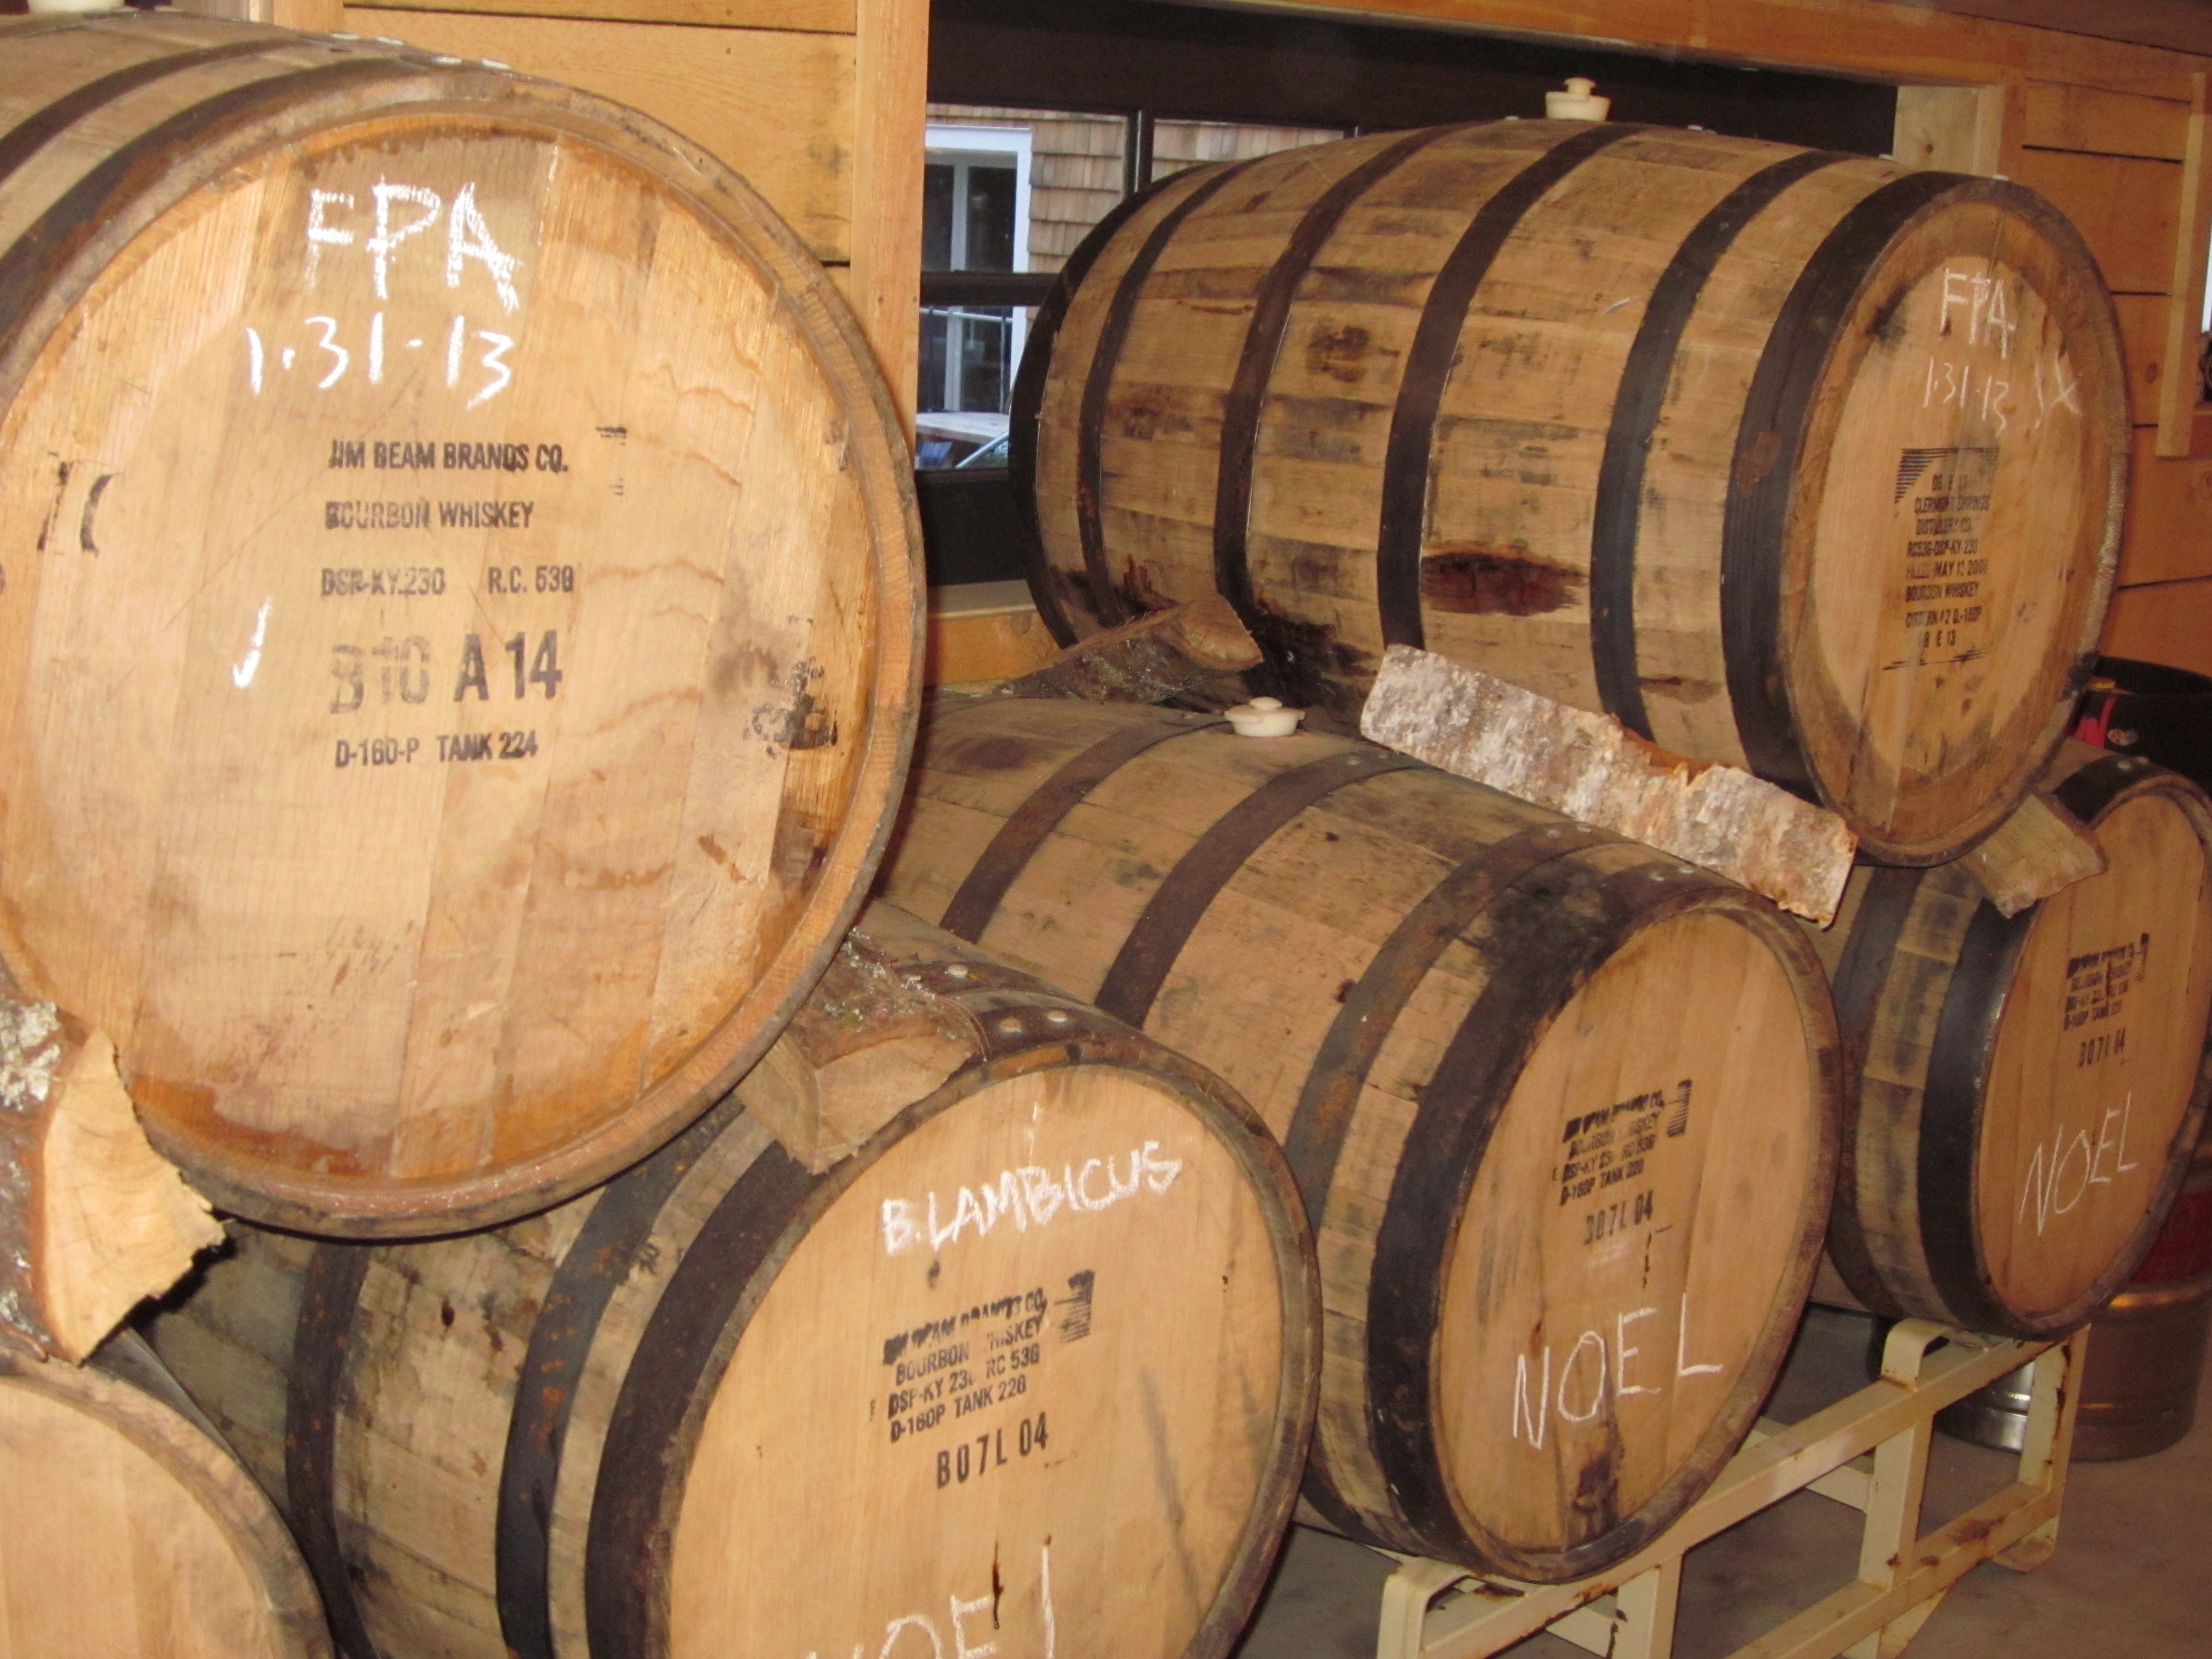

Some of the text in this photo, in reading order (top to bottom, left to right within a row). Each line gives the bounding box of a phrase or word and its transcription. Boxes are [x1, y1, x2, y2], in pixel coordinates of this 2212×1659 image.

[306, 176, 523, 314] FPA
[1941, 268, 2016, 359] FPA
[328, 440, 568, 473] JIM BEAM BRANDS CO.
[325, 500, 535, 529] BOURBON WHISKEY
[1914, 495, 1957, 514] CLERMOT
[488, 565, 527, 594] R.C.
[1935, 560, 1955, 577] MAY
[1945, 581, 1980, 598] WHISKEY
[453, 633, 489, 702] A
[505, 629, 562, 700] 14
[335, 729, 539, 768] D-160-P TANK 224
[1601, 1166, 1624, 1189] TANK
[2018, 1091, 2139, 1237] NOEL
[1635, 1189, 1654, 1226] 04
[896, 1343, 969, 1386] BOURBON
[987, 1314, 1042, 1350] HISKEY
[986, 1354, 1006, 1379] RC
[1513, 1293, 1723, 1450] NOEL
[890, 1404, 946, 1444] D-160P
[954, 1385, 994, 1418] TANK
[1019, 1412, 1048, 1457] 04
